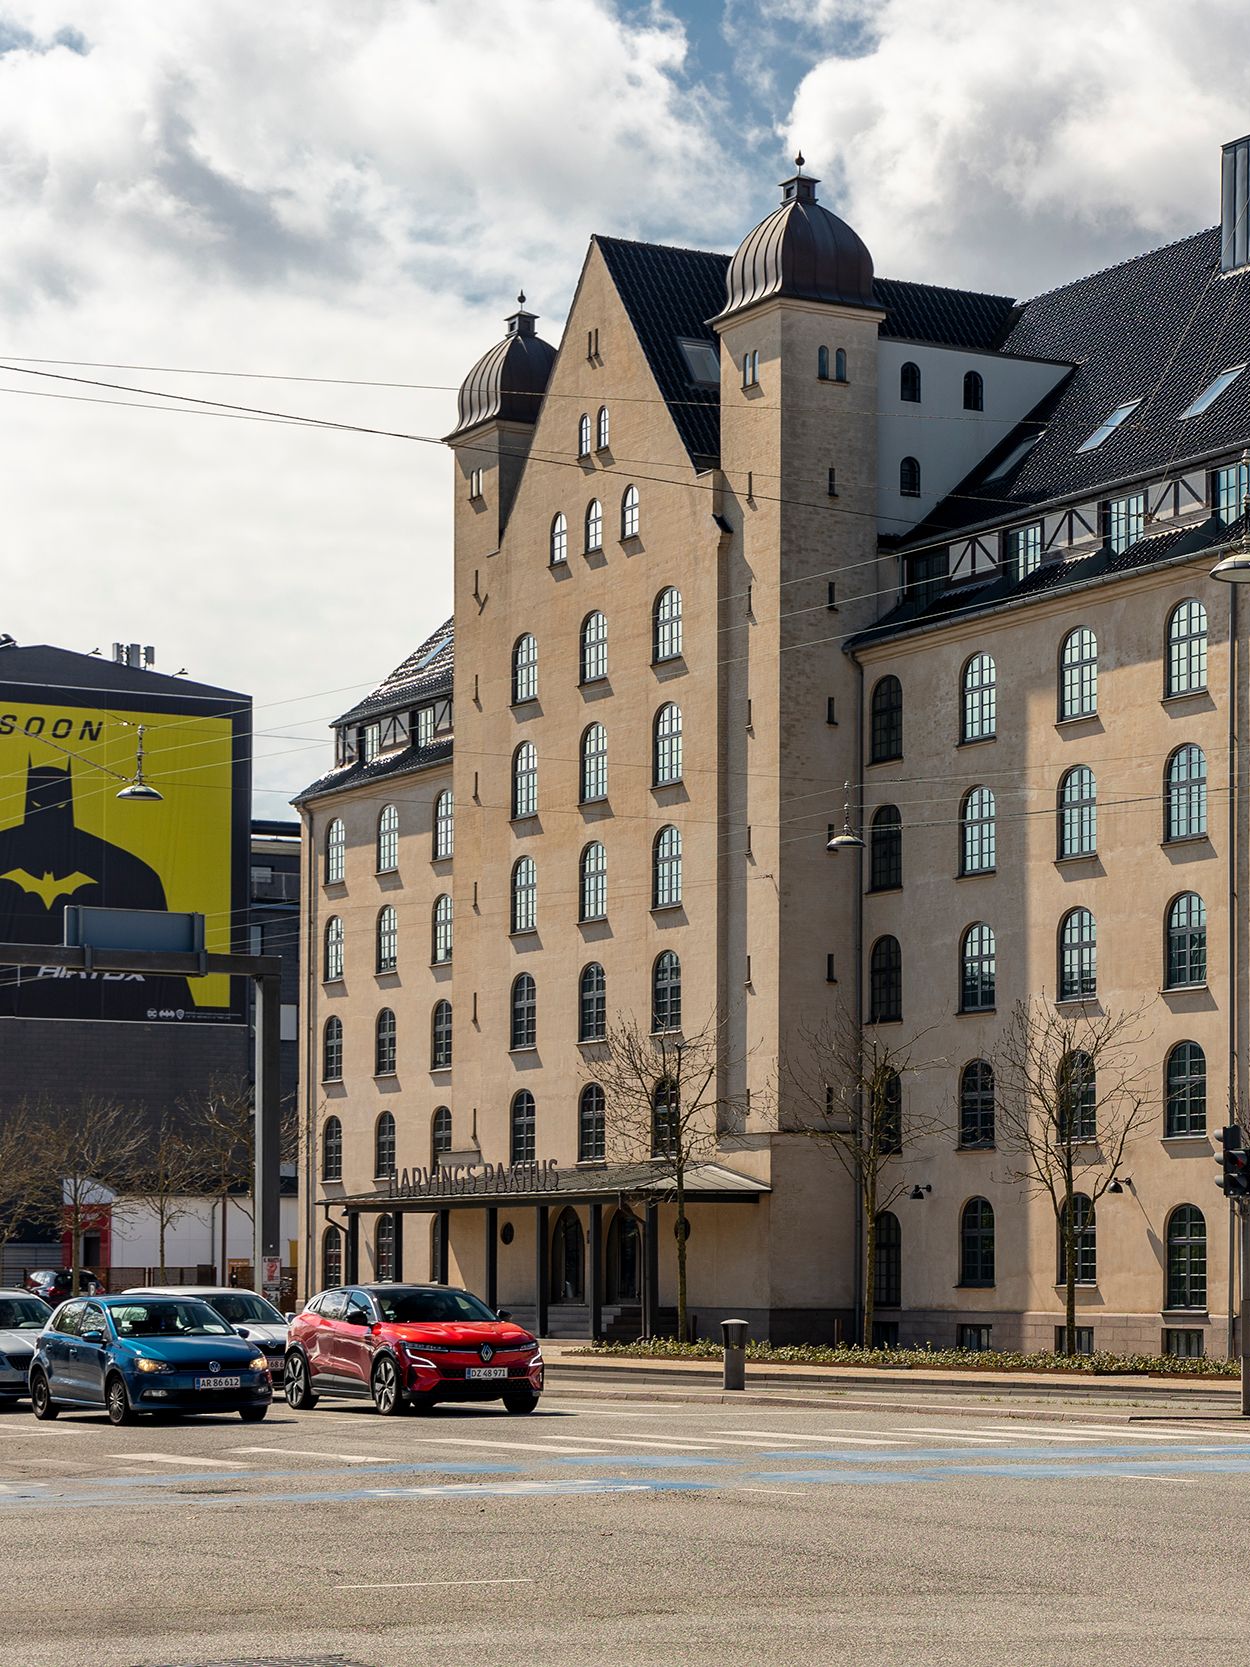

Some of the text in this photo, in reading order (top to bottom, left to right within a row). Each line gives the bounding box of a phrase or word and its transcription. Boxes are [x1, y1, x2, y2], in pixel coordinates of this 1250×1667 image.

[0, 714, 103, 741] SOON
[388, 1158, 560, 1197] HARVINGS PAKHUS
[201, 1378, 239, 1387] AR 86 612
